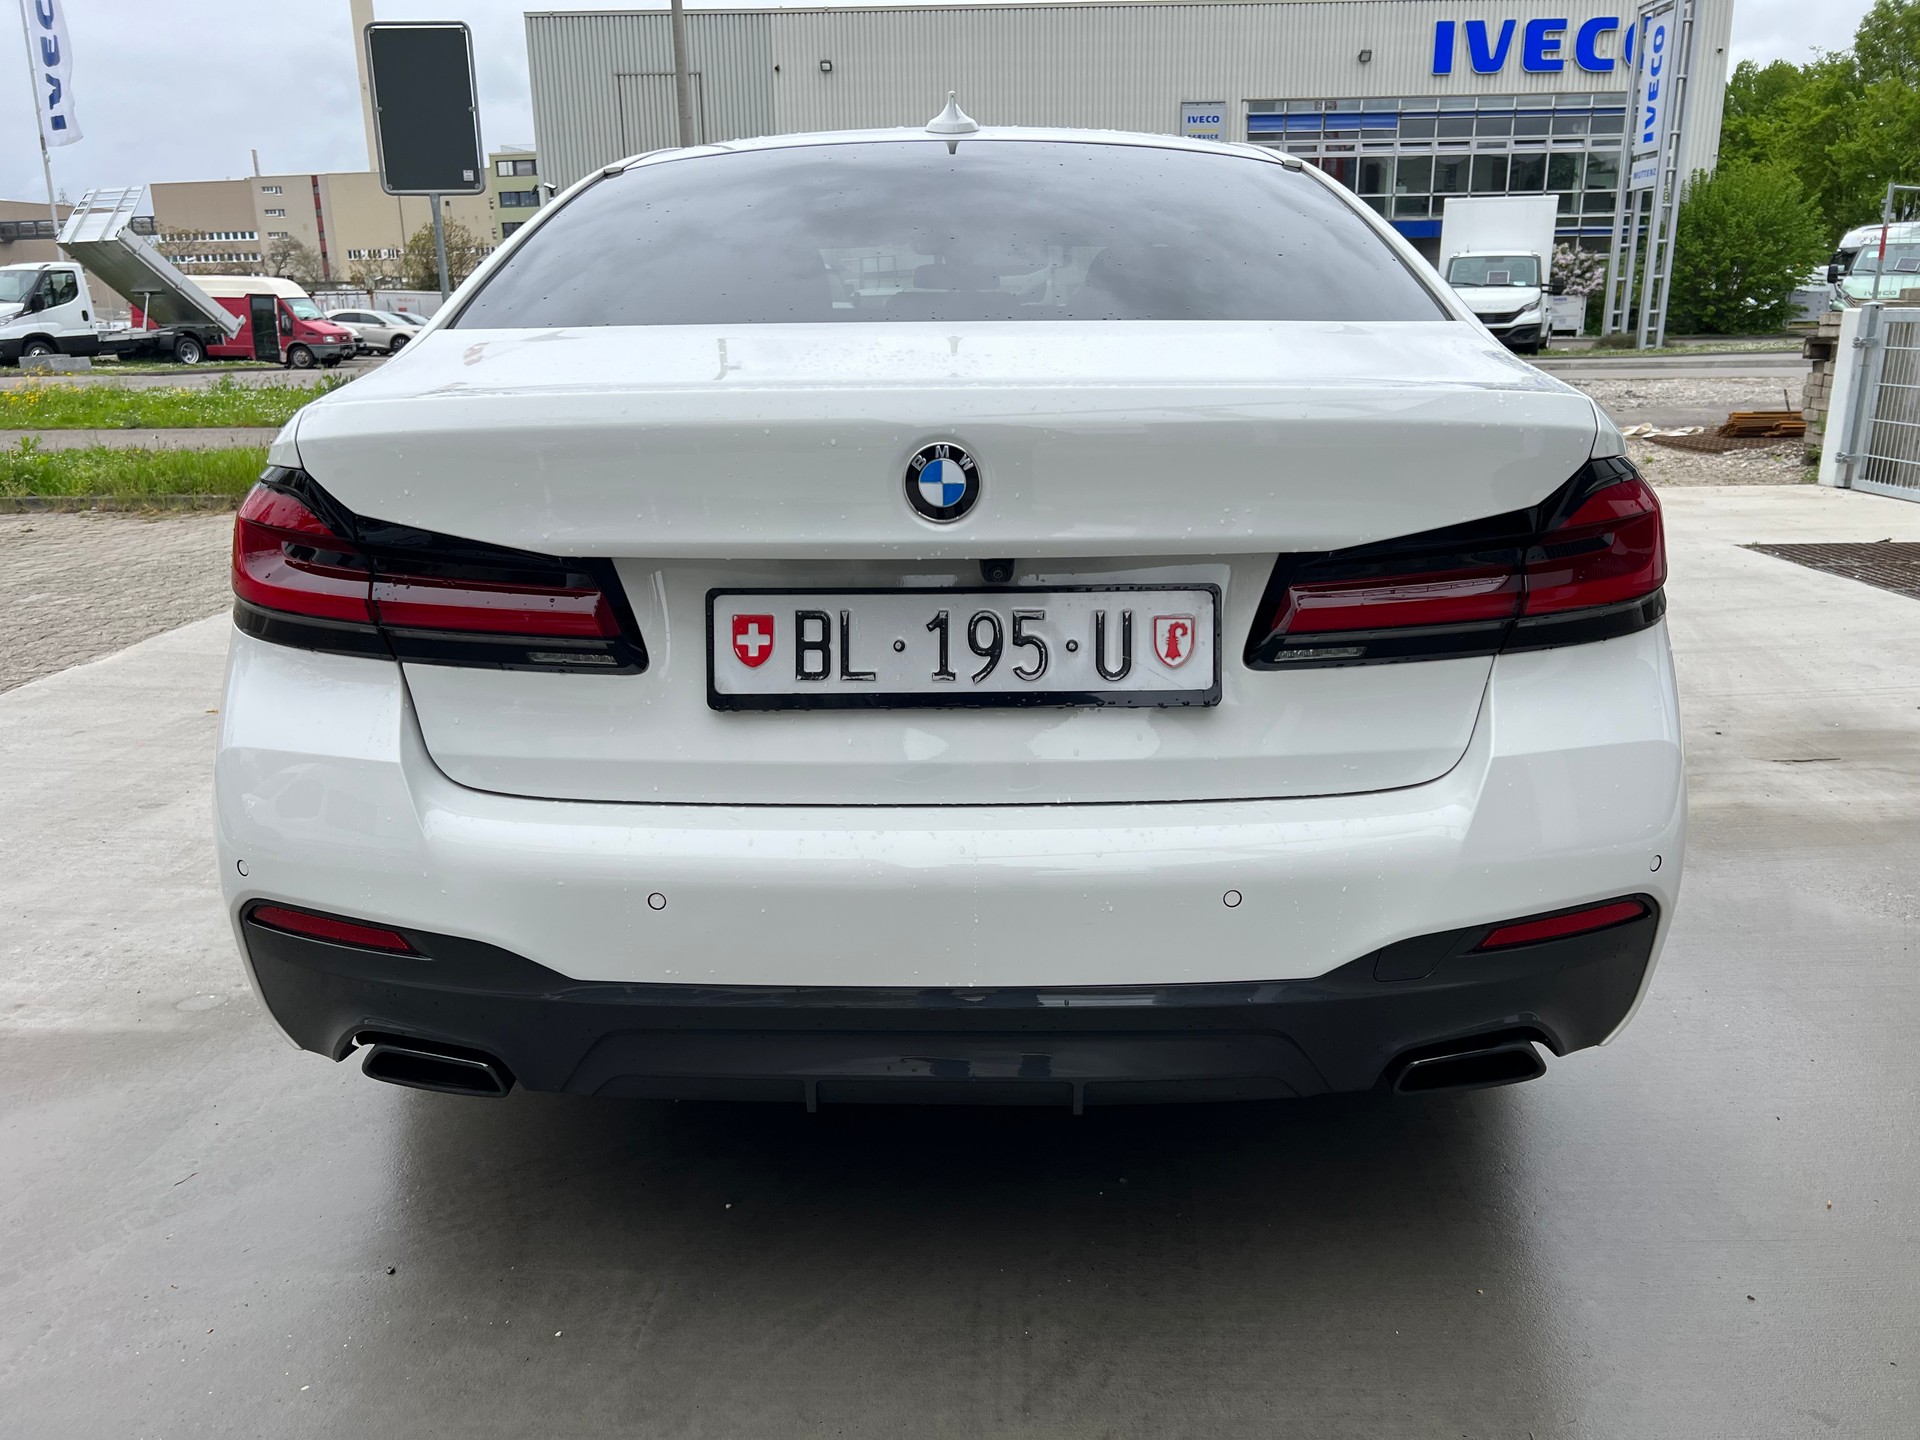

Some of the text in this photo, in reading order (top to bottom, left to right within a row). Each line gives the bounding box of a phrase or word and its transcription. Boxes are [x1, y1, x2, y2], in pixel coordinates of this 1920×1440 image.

[1642, 25, 1666, 143] IVECO
[1187, 115, 1220, 123] IVECO
[1633, 168, 1657, 179] MUTTENZ
[911, 445, 975, 472] BMW
[924, 608, 1049, 685] 195
